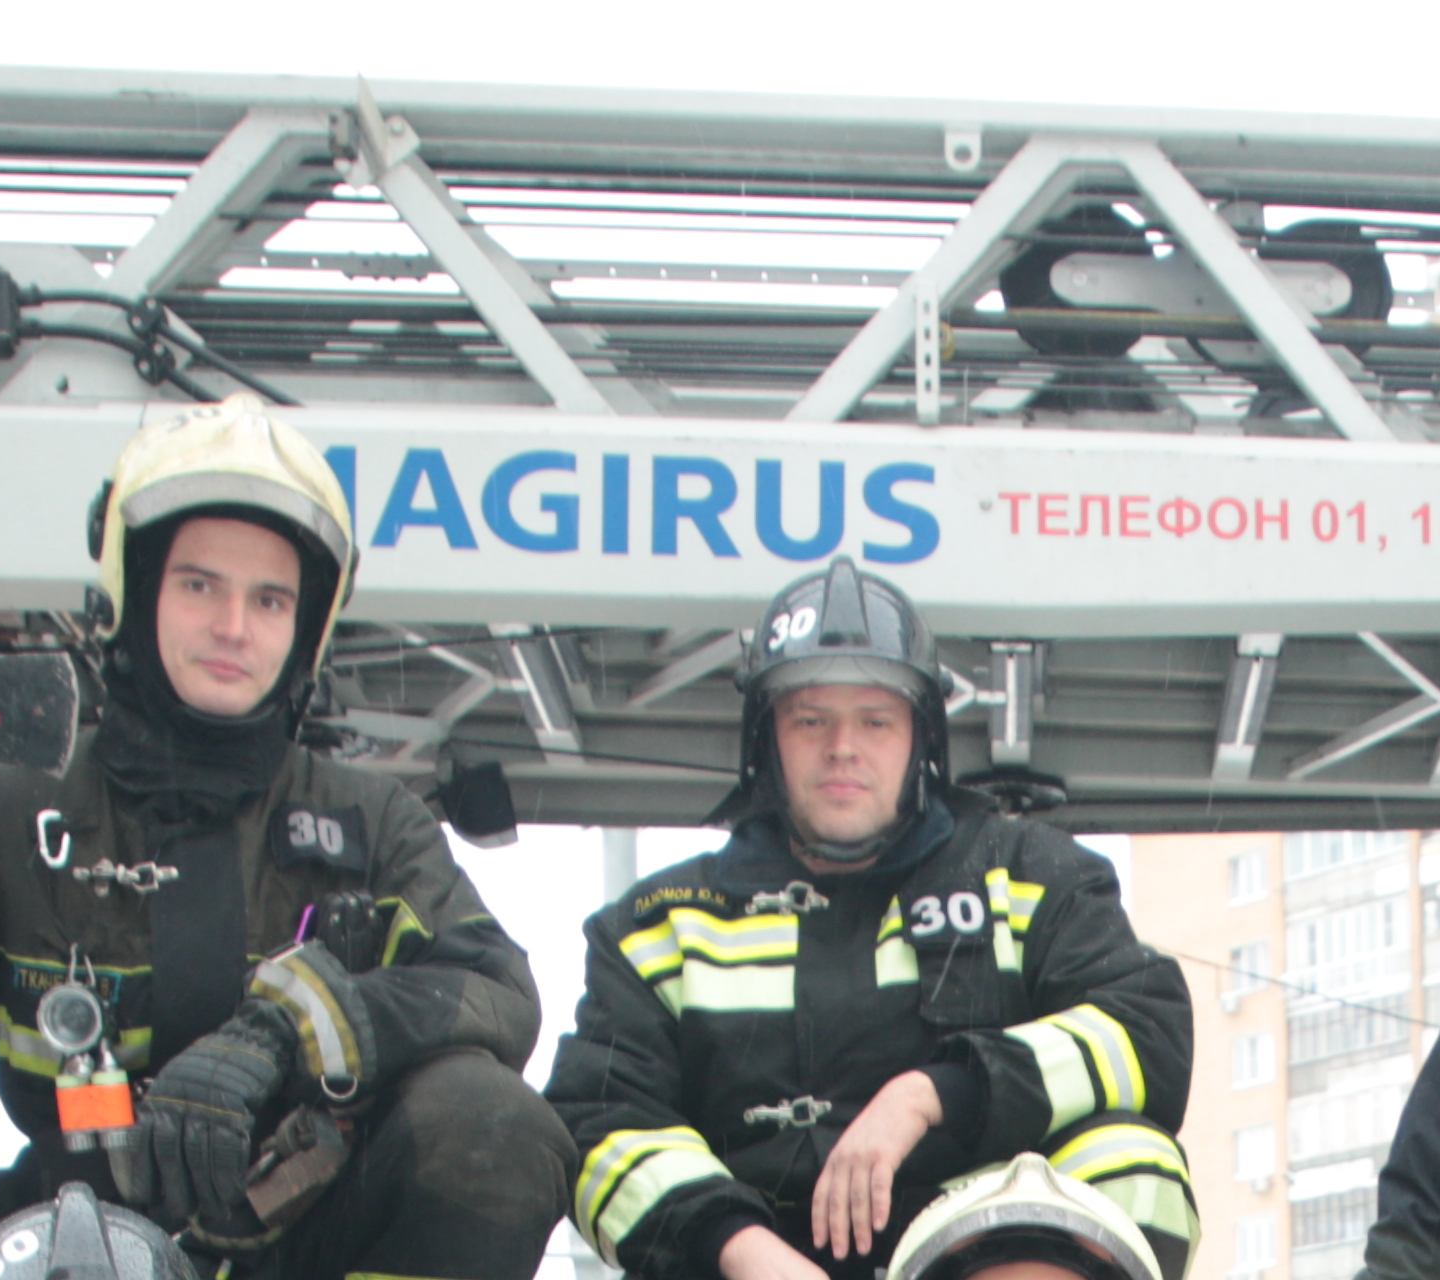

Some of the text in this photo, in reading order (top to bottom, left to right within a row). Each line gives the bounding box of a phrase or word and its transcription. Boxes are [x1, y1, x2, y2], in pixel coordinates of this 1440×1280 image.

[998, 492, 1290, 541] ТЕЛЕФОН
[1311, 499, 1388, 552] 01,
[769, 607, 817, 652] 30
[288, 811, 344, 855] 30
[910, 891, 985, 936] 30
